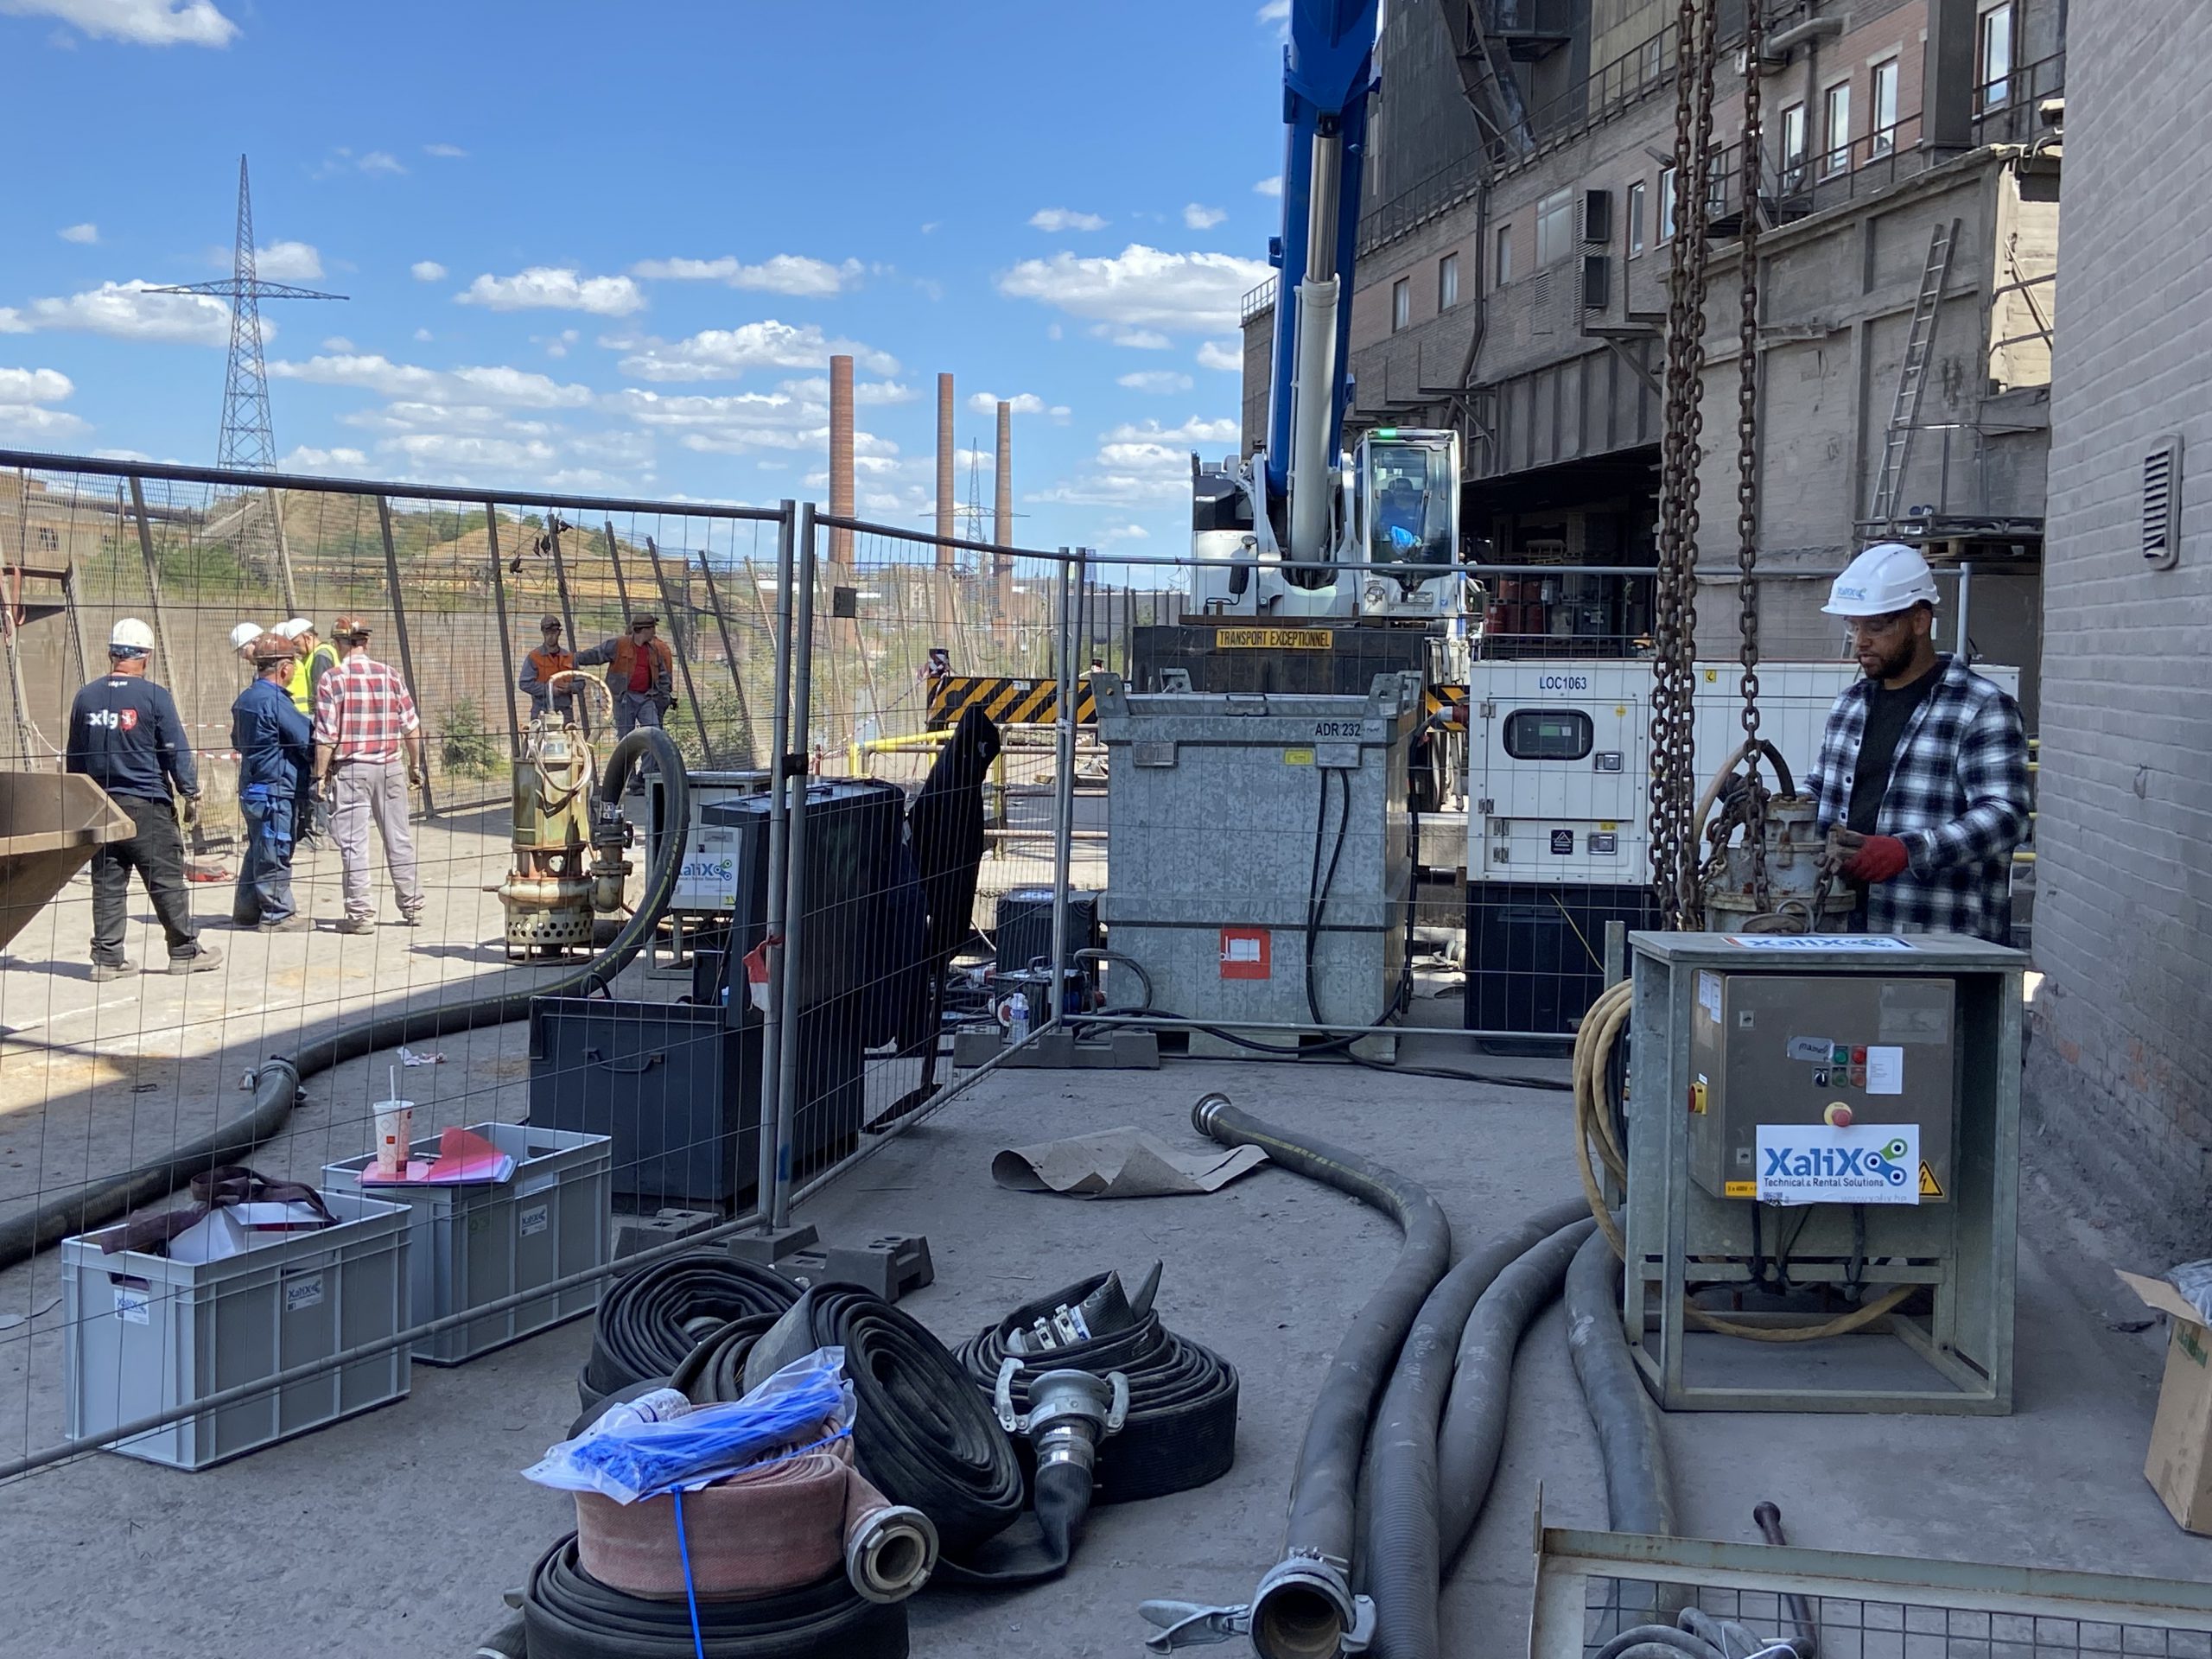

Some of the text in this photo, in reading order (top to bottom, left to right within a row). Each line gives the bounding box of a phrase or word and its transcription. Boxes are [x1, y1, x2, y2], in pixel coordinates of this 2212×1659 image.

[1219, 631, 1330, 646] TRANSPORT EXCEPTIONNEL
[1539, 677, 1586, 690] LOC1063
[1314, 722, 1339, 736] ADR
[1342, 723, 1361, 737] 232
[1764, 1147, 1865, 1177] XaliX
[1764, 1178, 1805, 1187] Technical
[1813, 1178, 1842, 1187] Rental
[1843, 1178, 1884, 1187] Solutions
